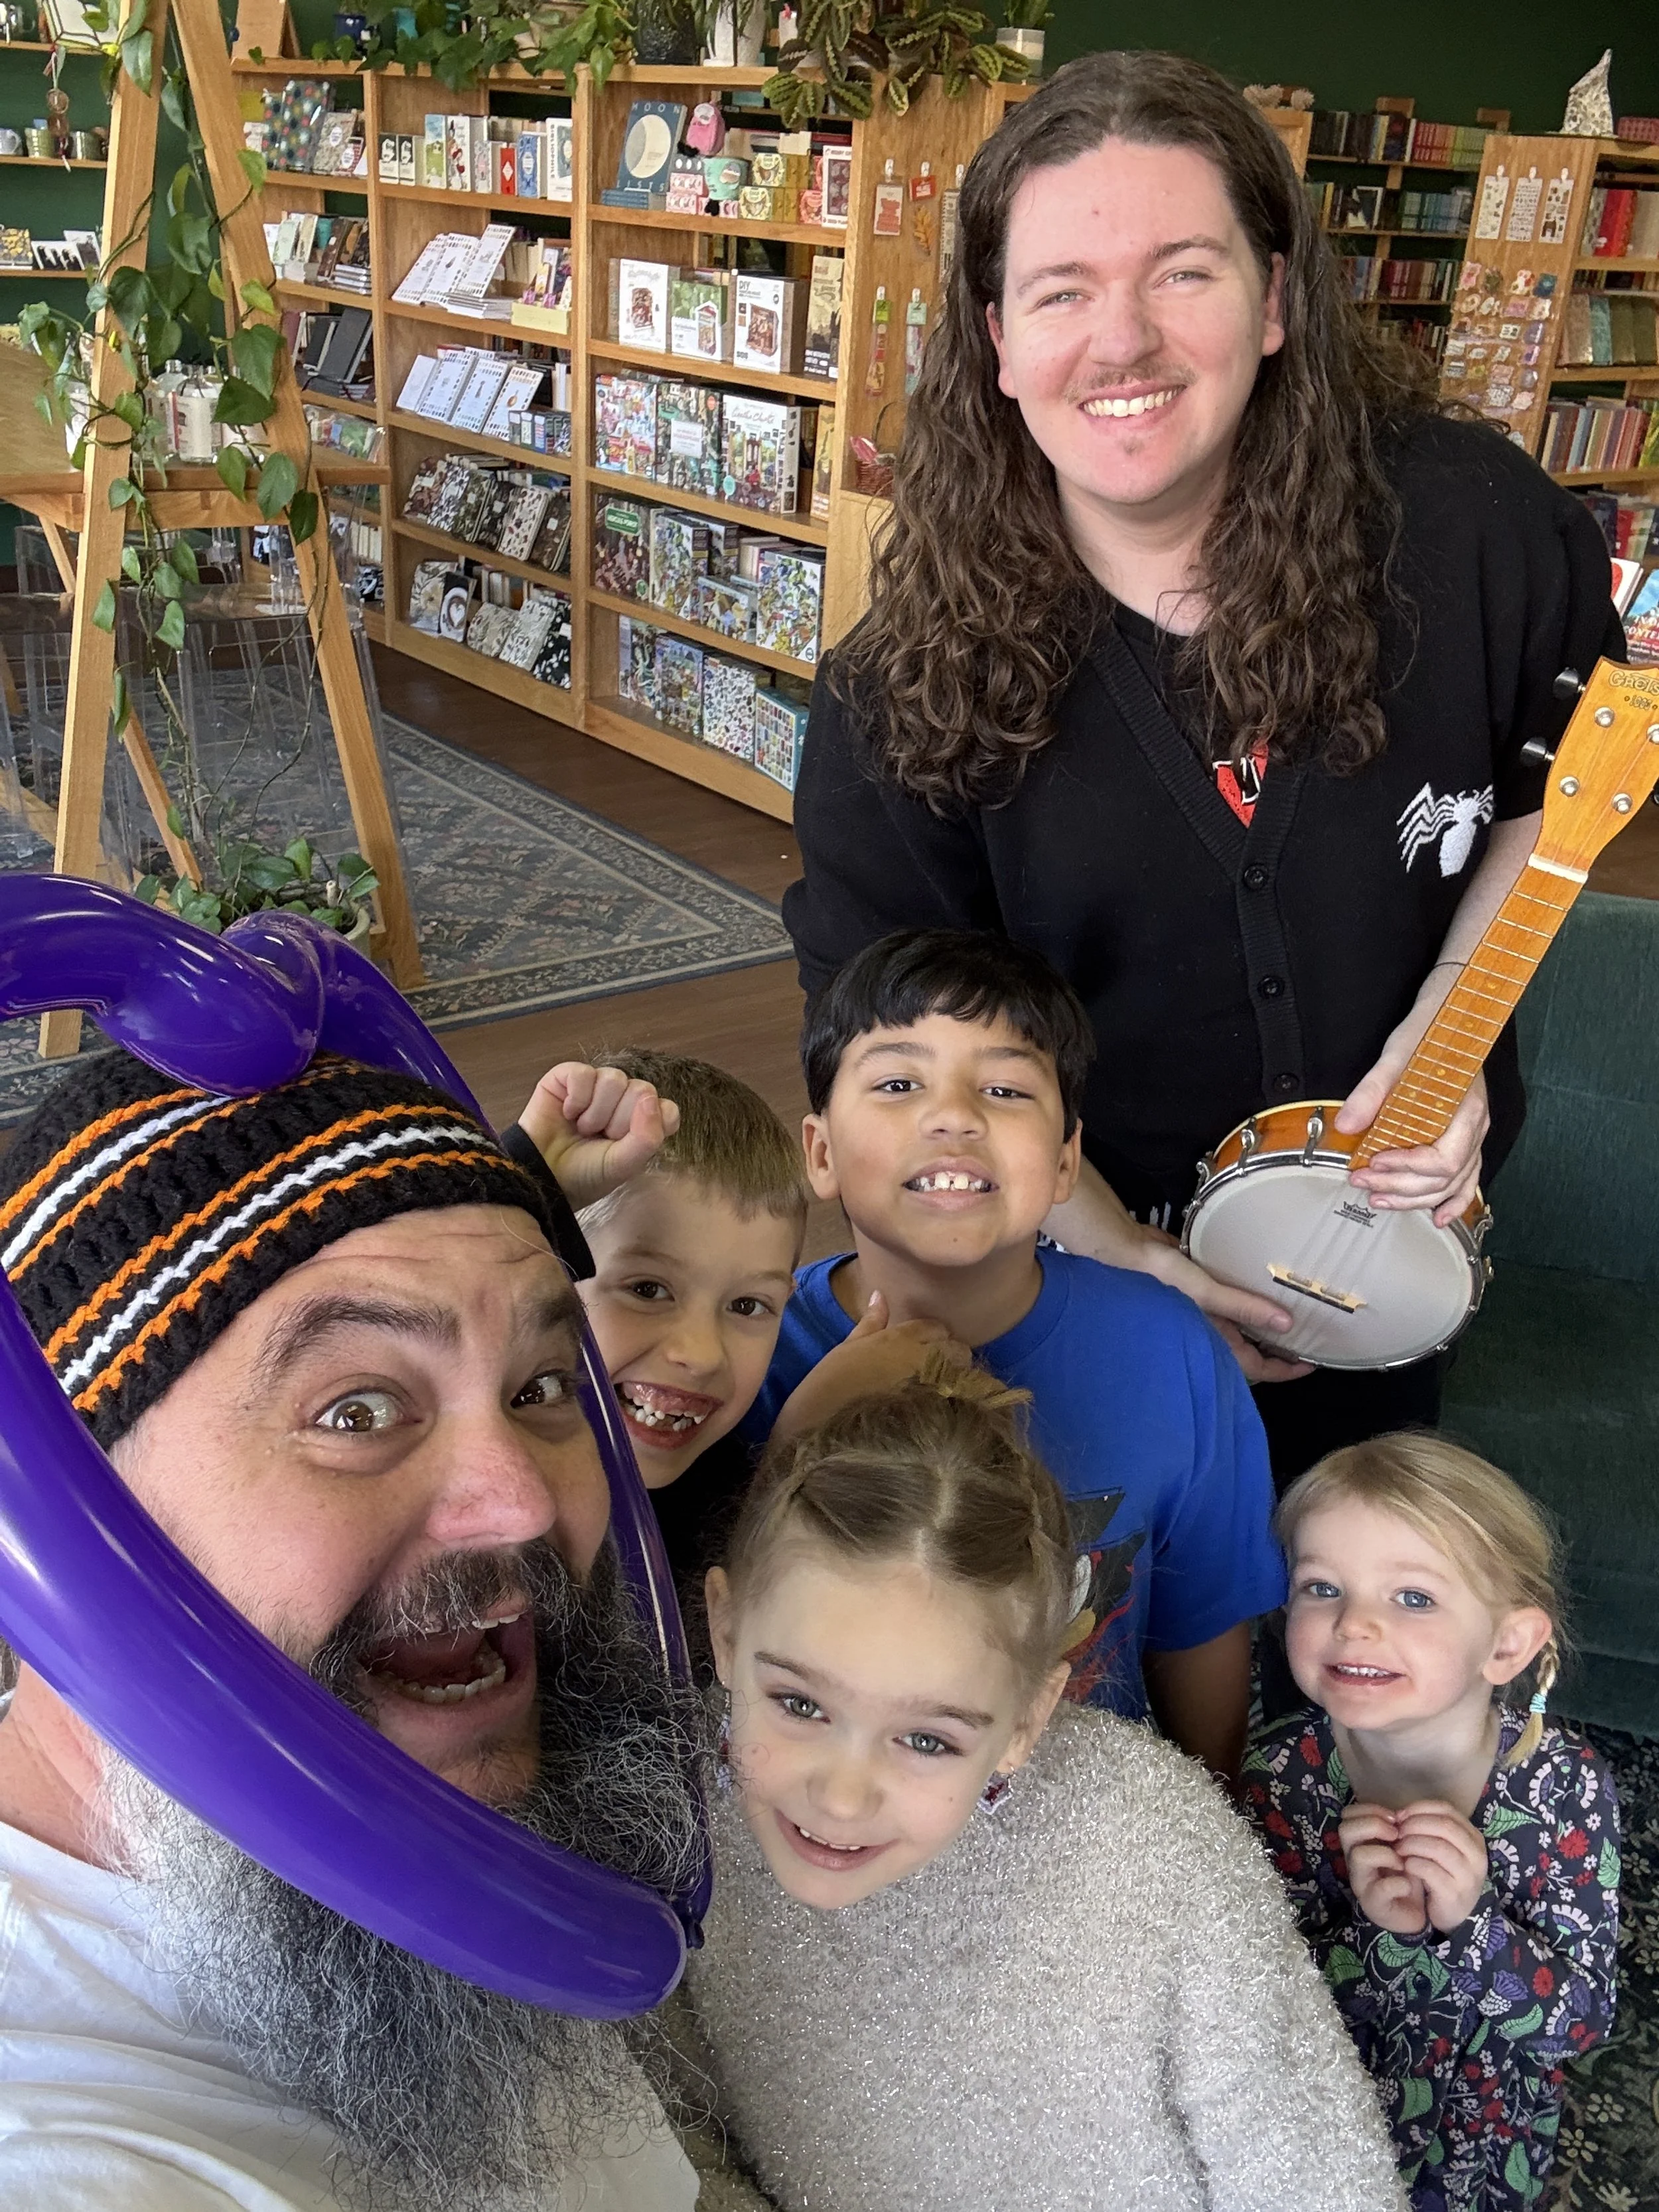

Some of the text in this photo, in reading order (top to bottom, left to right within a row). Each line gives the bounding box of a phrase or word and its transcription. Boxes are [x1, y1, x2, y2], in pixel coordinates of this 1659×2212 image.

[631, 102, 681, 114] MOON
[616, 179, 666, 192] LISTS
[739, 280, 751, 291] DIY
